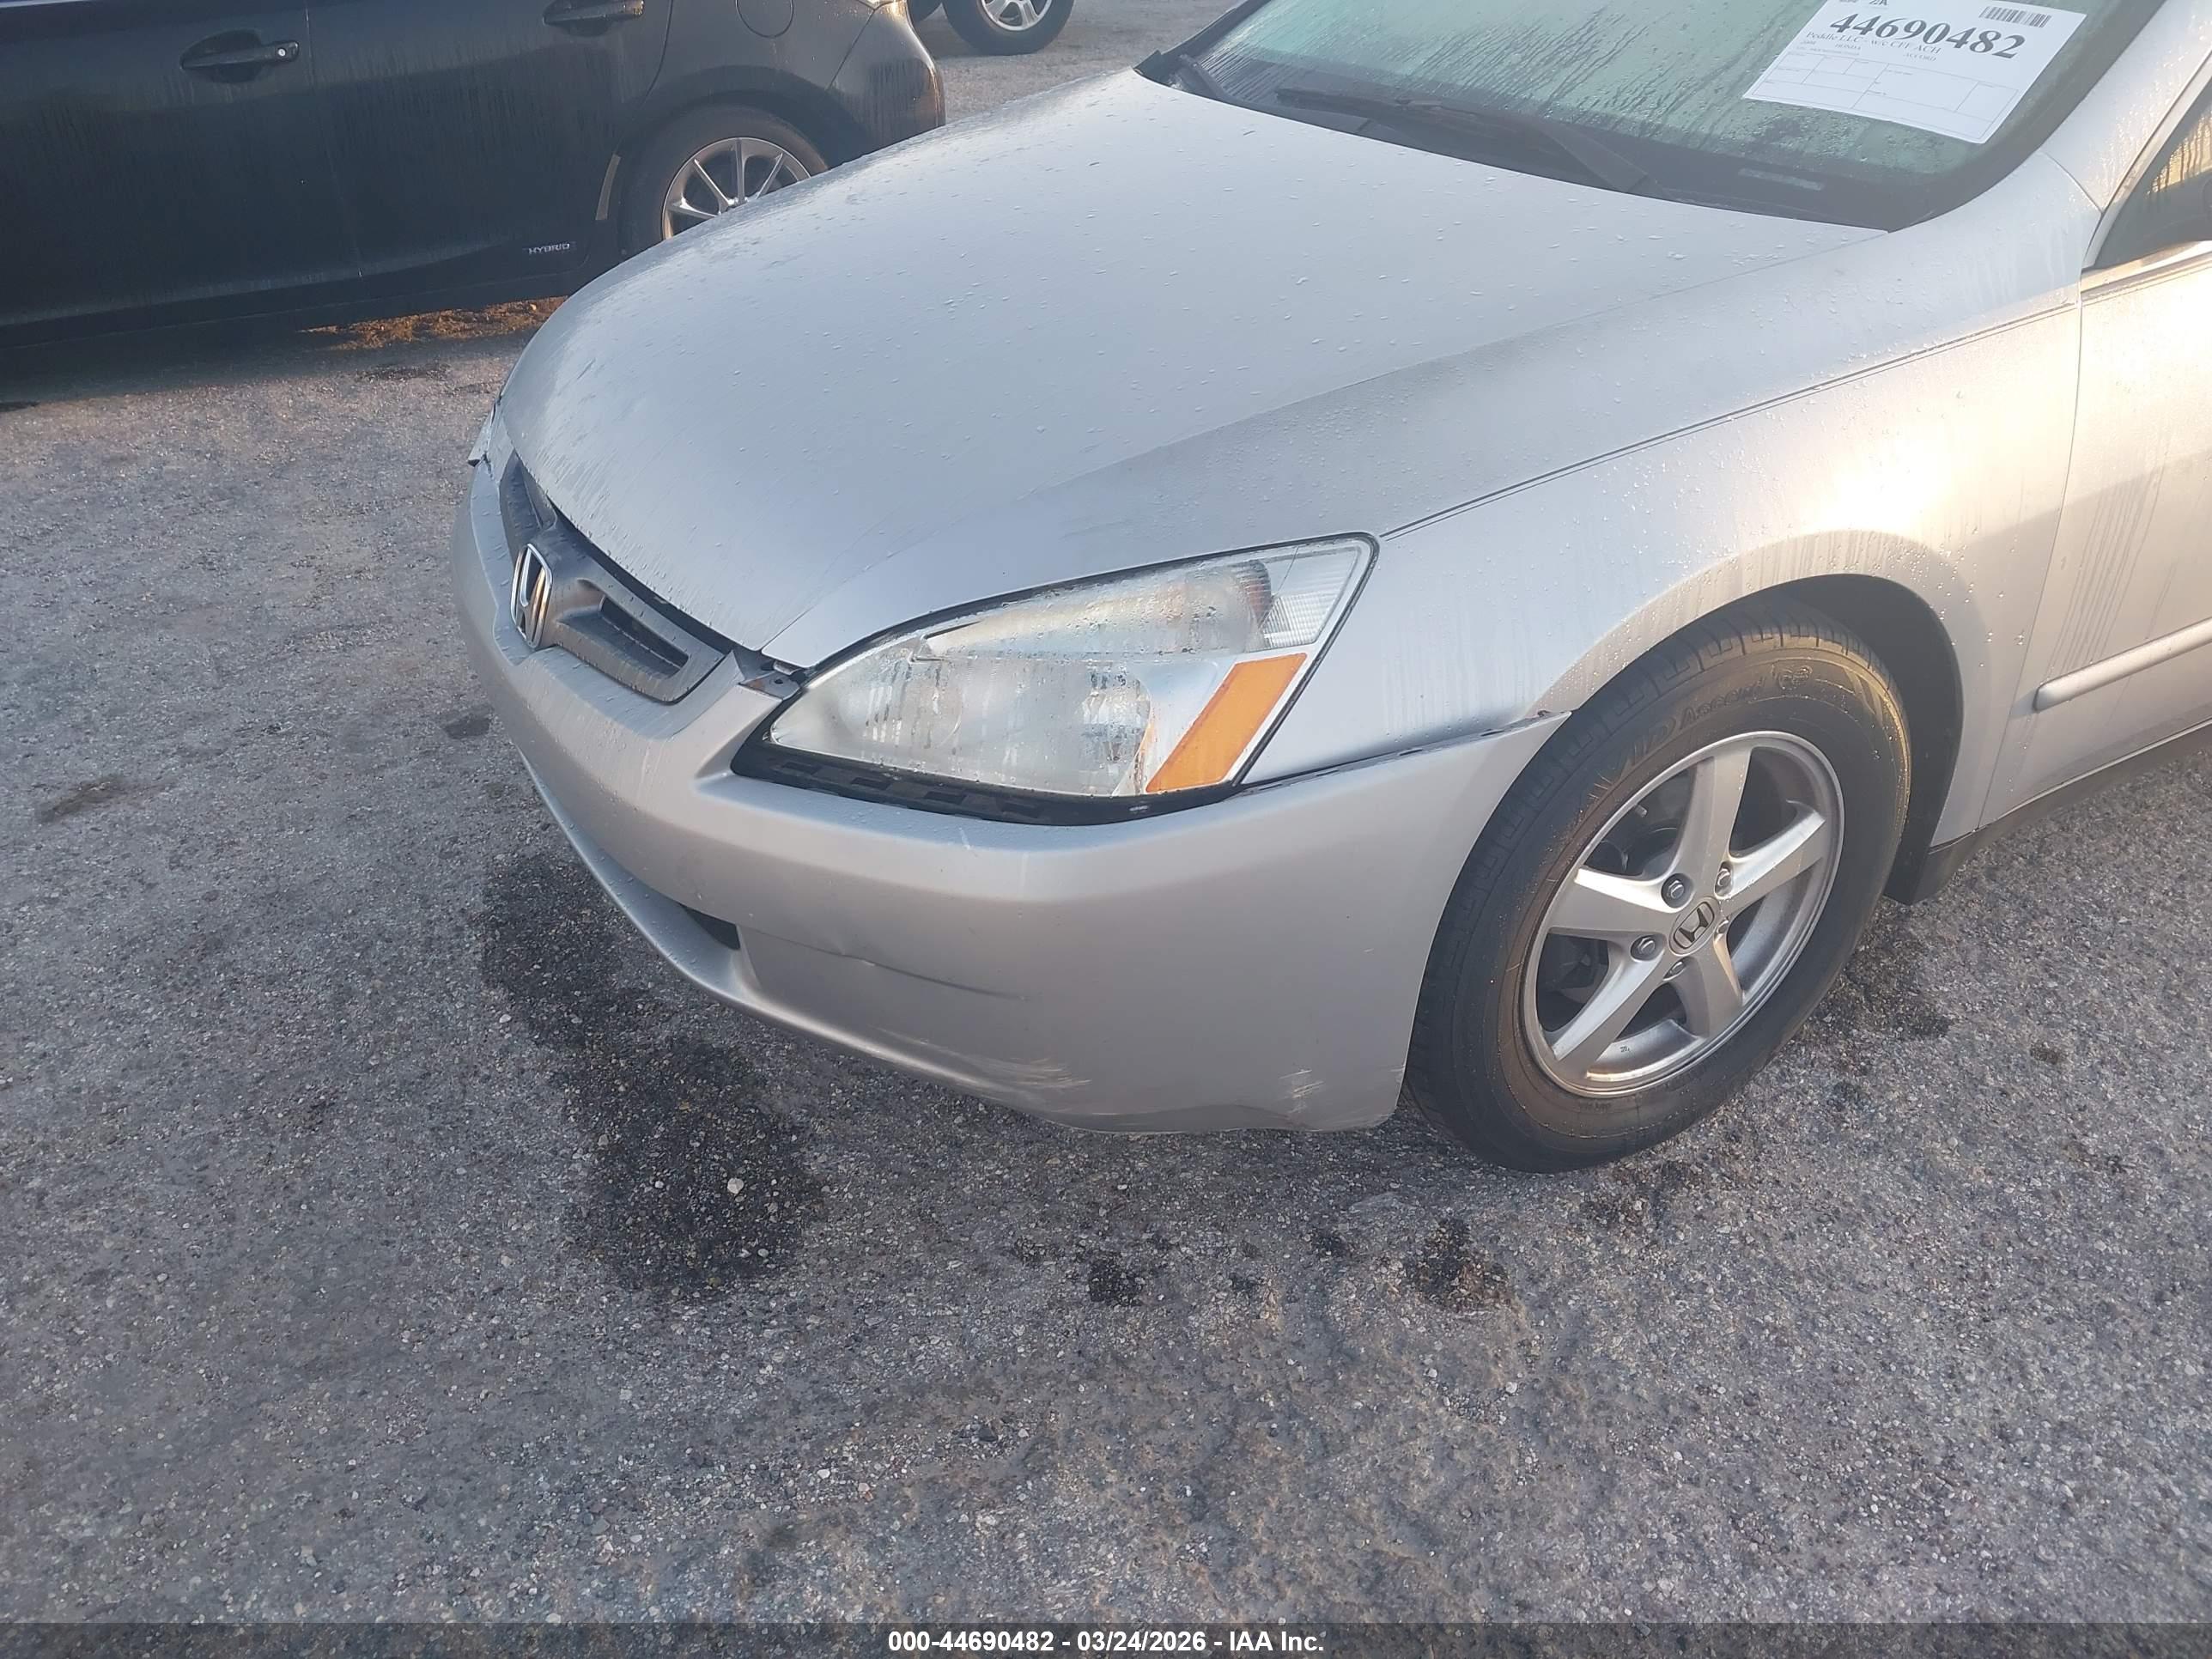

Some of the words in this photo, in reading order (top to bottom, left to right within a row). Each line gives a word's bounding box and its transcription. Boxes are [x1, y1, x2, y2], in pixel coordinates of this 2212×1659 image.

[1806, 31, 1838, 41] Peddle
[1839, 34, 1864, 43] LLC
[1914, 44, 1942, 54] ACH
[1830, 13, 2026, 59] 44690482
[528, 243, 571, 255] HYBRID
